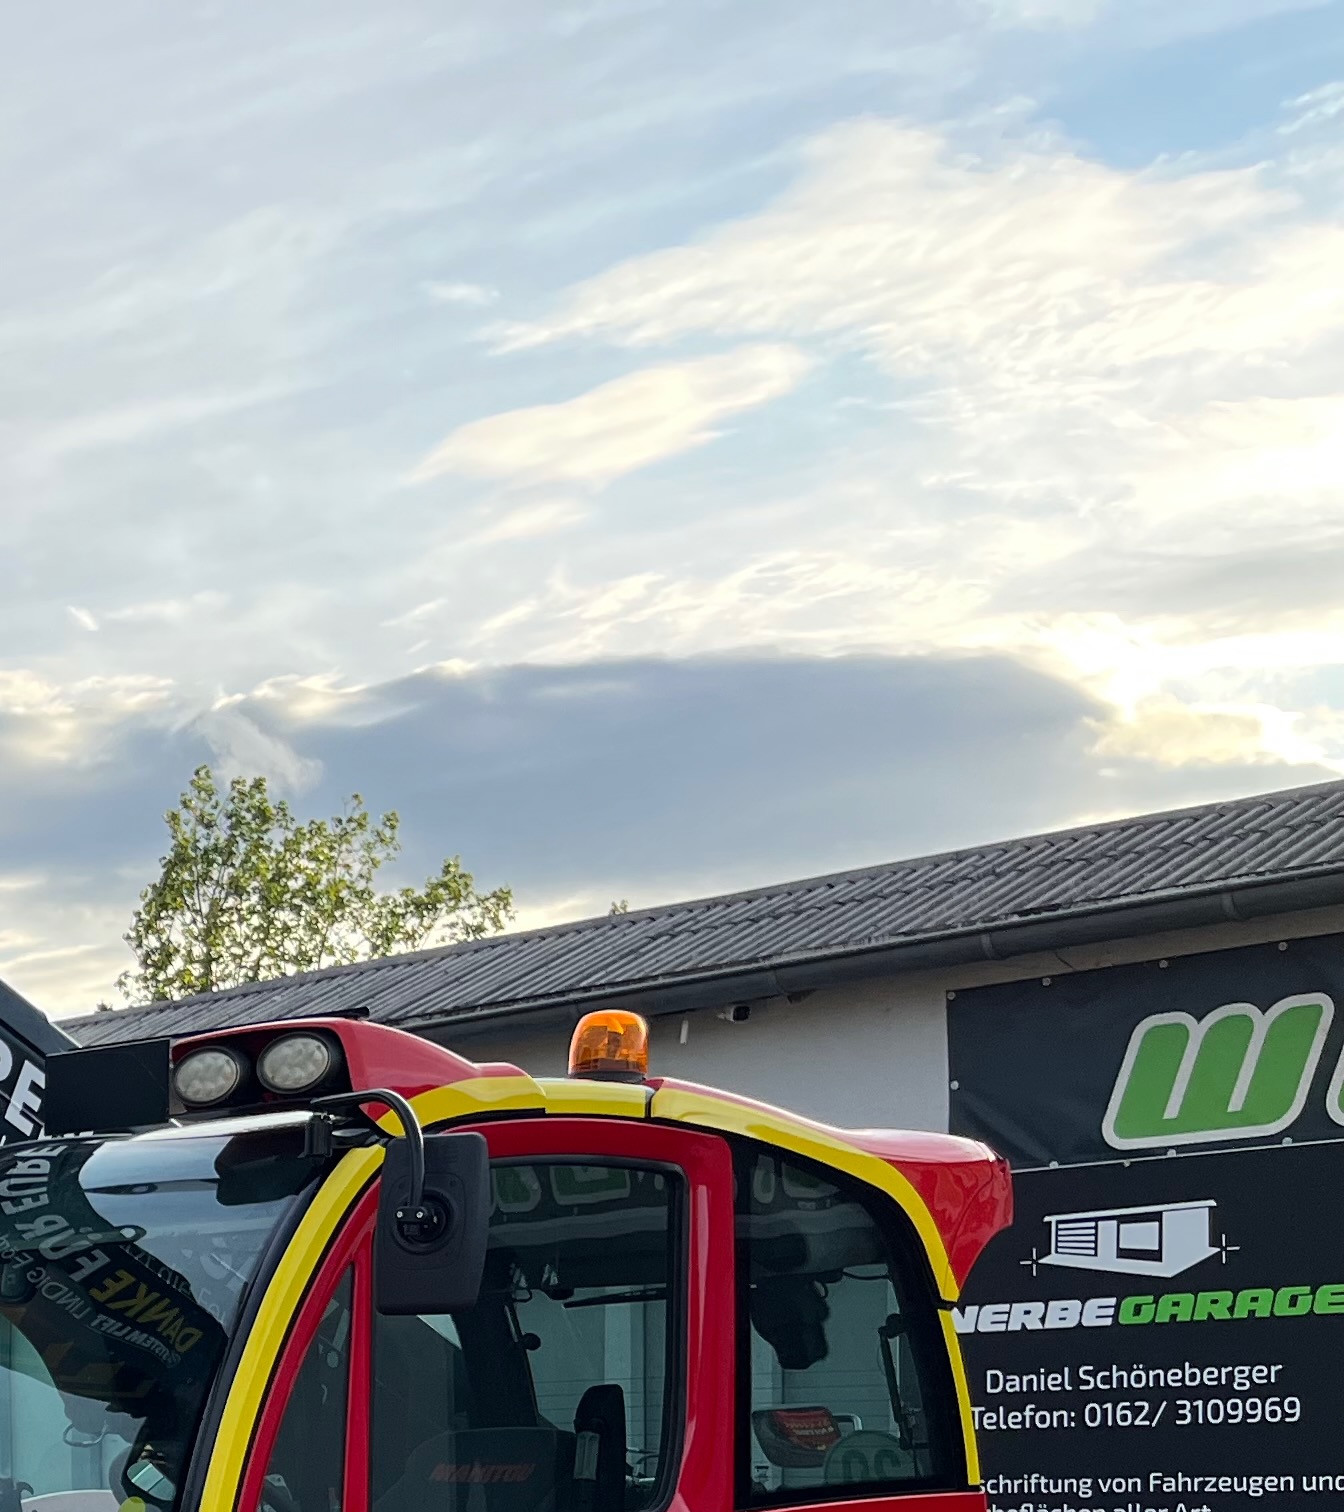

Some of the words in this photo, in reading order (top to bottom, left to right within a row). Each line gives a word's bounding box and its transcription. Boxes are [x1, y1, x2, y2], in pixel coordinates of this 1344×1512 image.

[986, 1366, 1073, 1394] Daniel
[1079, 1362, 1283, 1391] Schöneberger
[971, 1404, 1076, 1430] Telefon:
[1084, 1400, 1167, 1428] 0162/
[1175, 1396, 1301, 1425] 3109969
[1097, 1477, 1142, 1493] von
[1149, 1472, 1295, 1497] Fahrzeugen
